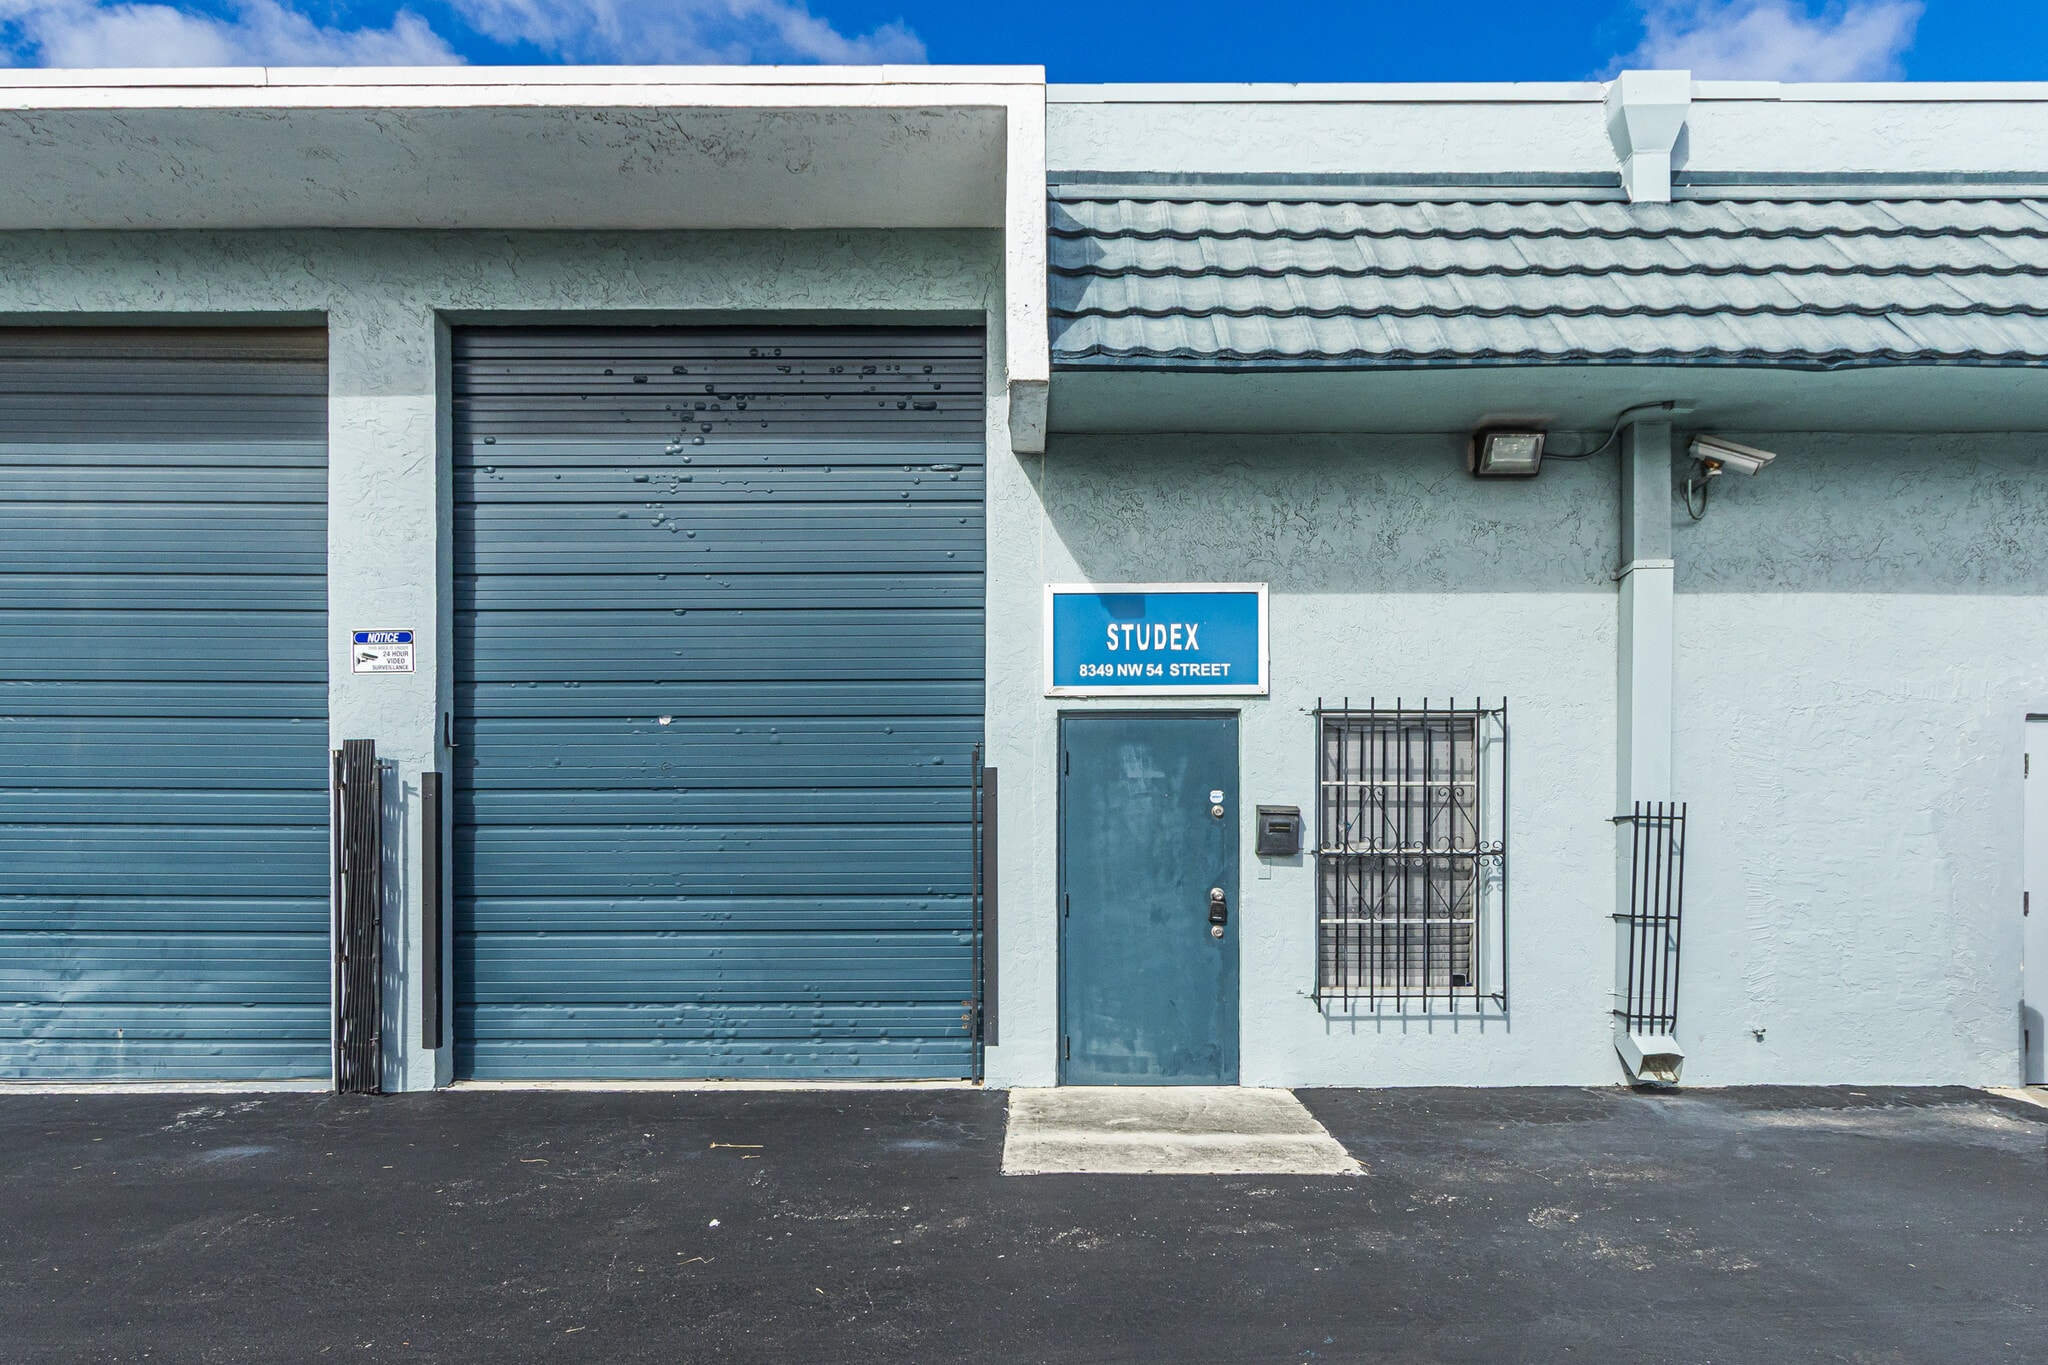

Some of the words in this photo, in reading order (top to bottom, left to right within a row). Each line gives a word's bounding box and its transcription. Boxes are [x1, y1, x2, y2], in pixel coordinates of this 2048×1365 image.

[367, 632, 399, 643] NOTICE
[1106, 623, 1200, 651] STUDEX
[1079, 664, 1114, 677] 8349
[1117, 664, 1143, 676] NW
[1146, 664, 1163, 676] 54
[1169, 663, 1231, 676] STREET
